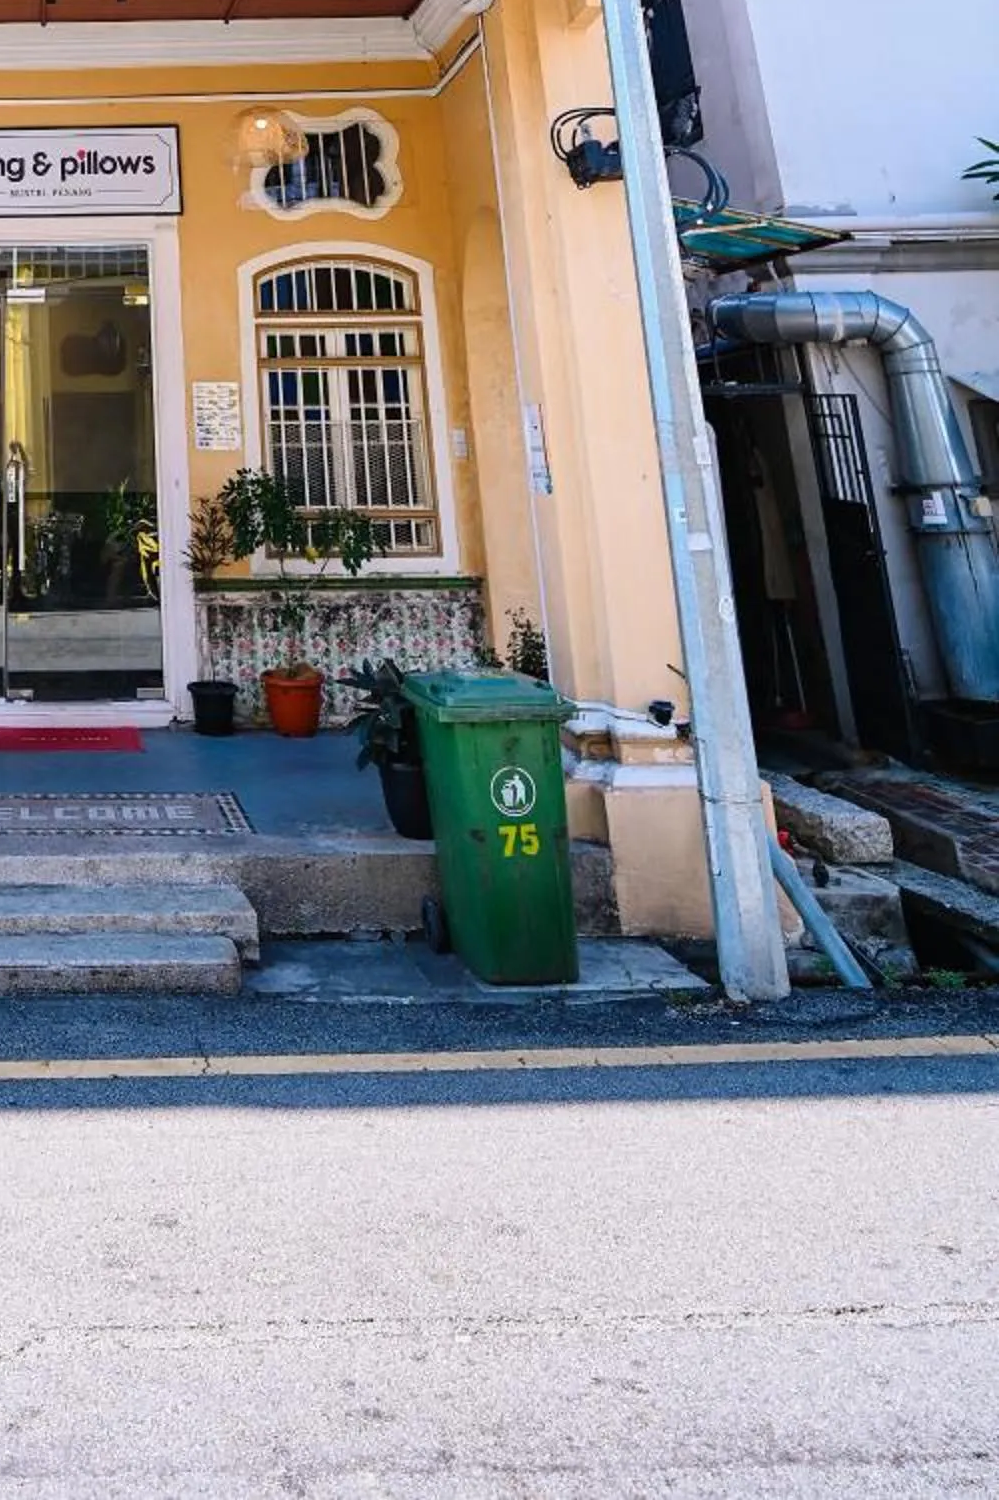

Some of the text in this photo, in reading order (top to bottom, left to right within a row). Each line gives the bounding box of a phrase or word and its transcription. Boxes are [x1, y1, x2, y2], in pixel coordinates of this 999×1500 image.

[32, 151, 52, 176] &
[60, 149, 156, 182] pillows
[498, 823, 539, 857] 75
